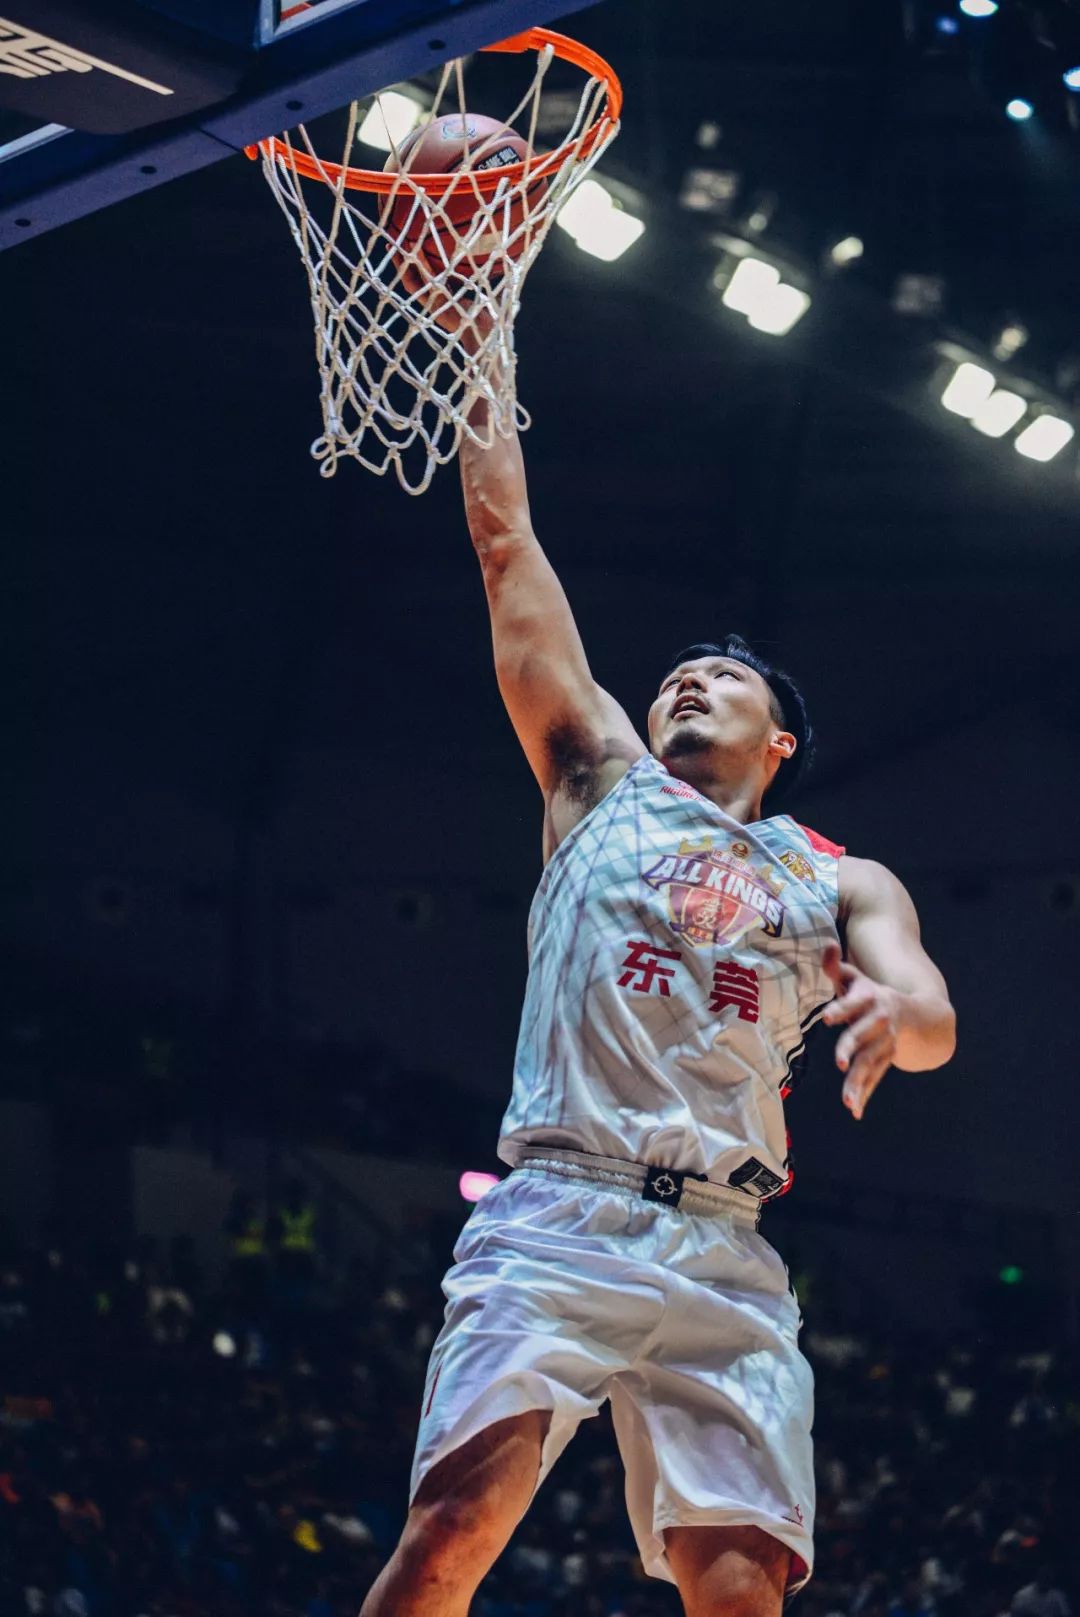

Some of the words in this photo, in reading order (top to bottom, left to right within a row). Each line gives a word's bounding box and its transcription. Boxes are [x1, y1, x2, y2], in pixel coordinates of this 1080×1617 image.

[648, 857, 702, 883] ALL
[704, 866, 784, 926] KINGS
[616, 940, 759, 1024] 东莞
